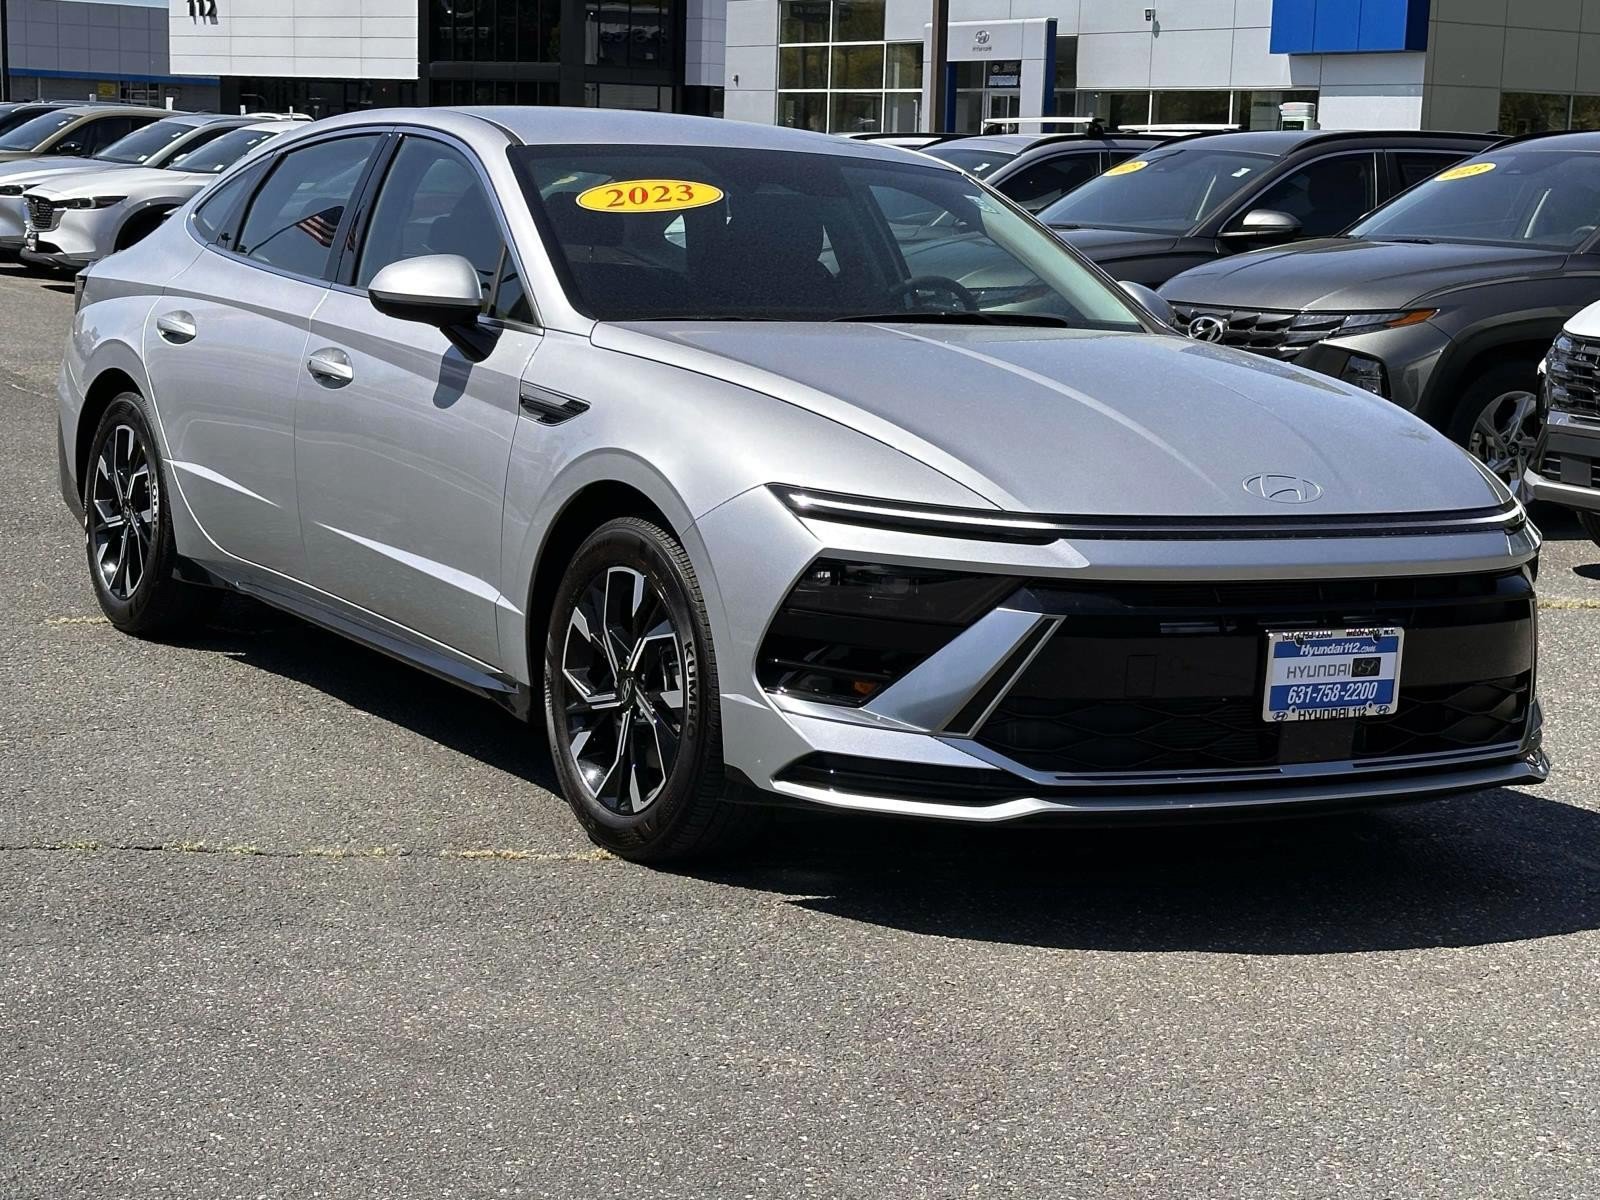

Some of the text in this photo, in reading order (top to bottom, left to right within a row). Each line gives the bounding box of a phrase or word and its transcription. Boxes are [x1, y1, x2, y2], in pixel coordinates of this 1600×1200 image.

[606, 184, 694, 207] 2023
[1287, 664, 1351, 679] HYUNDAI
[684, 641, 698, 738] KUMHO
[1287, 682, 1378, 704] 631-758-2200
[1298, 706, 1367, 721] HYUNDAI 112
